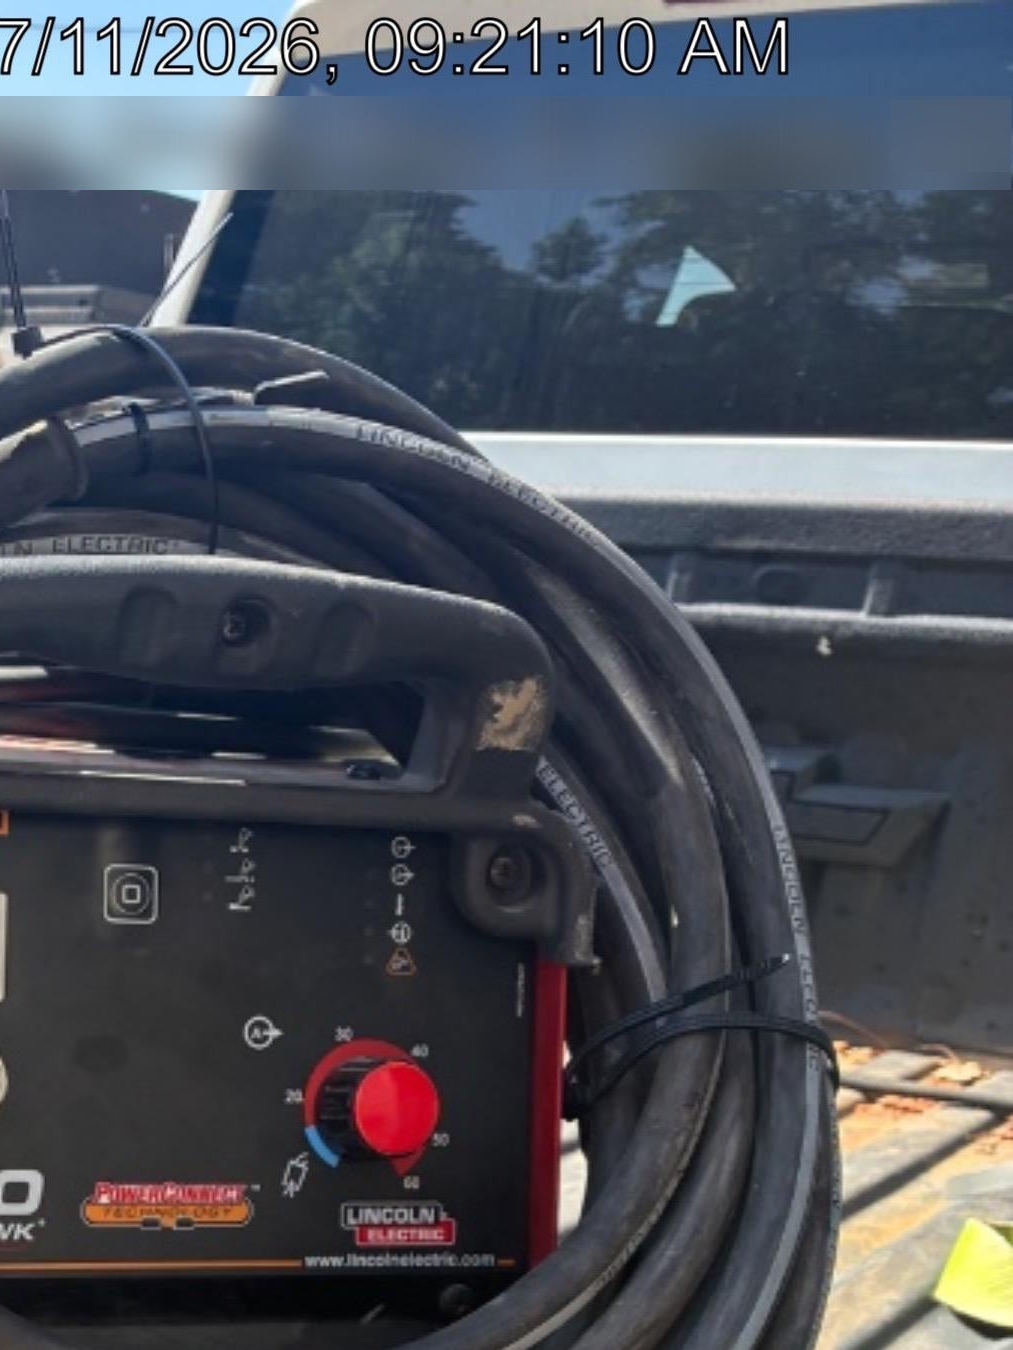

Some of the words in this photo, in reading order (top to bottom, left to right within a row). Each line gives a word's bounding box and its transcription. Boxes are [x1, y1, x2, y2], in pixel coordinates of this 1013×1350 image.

[411, 1044, 429, 1058] 40
[285, 1089, 303, 1104] 20
[346, 1207, 435, 1225] LINCOLN
[367, 1226, 445, 1241] ELECTRIC
[304, 1252, 495, 1268] www.lincolnelectric.com
